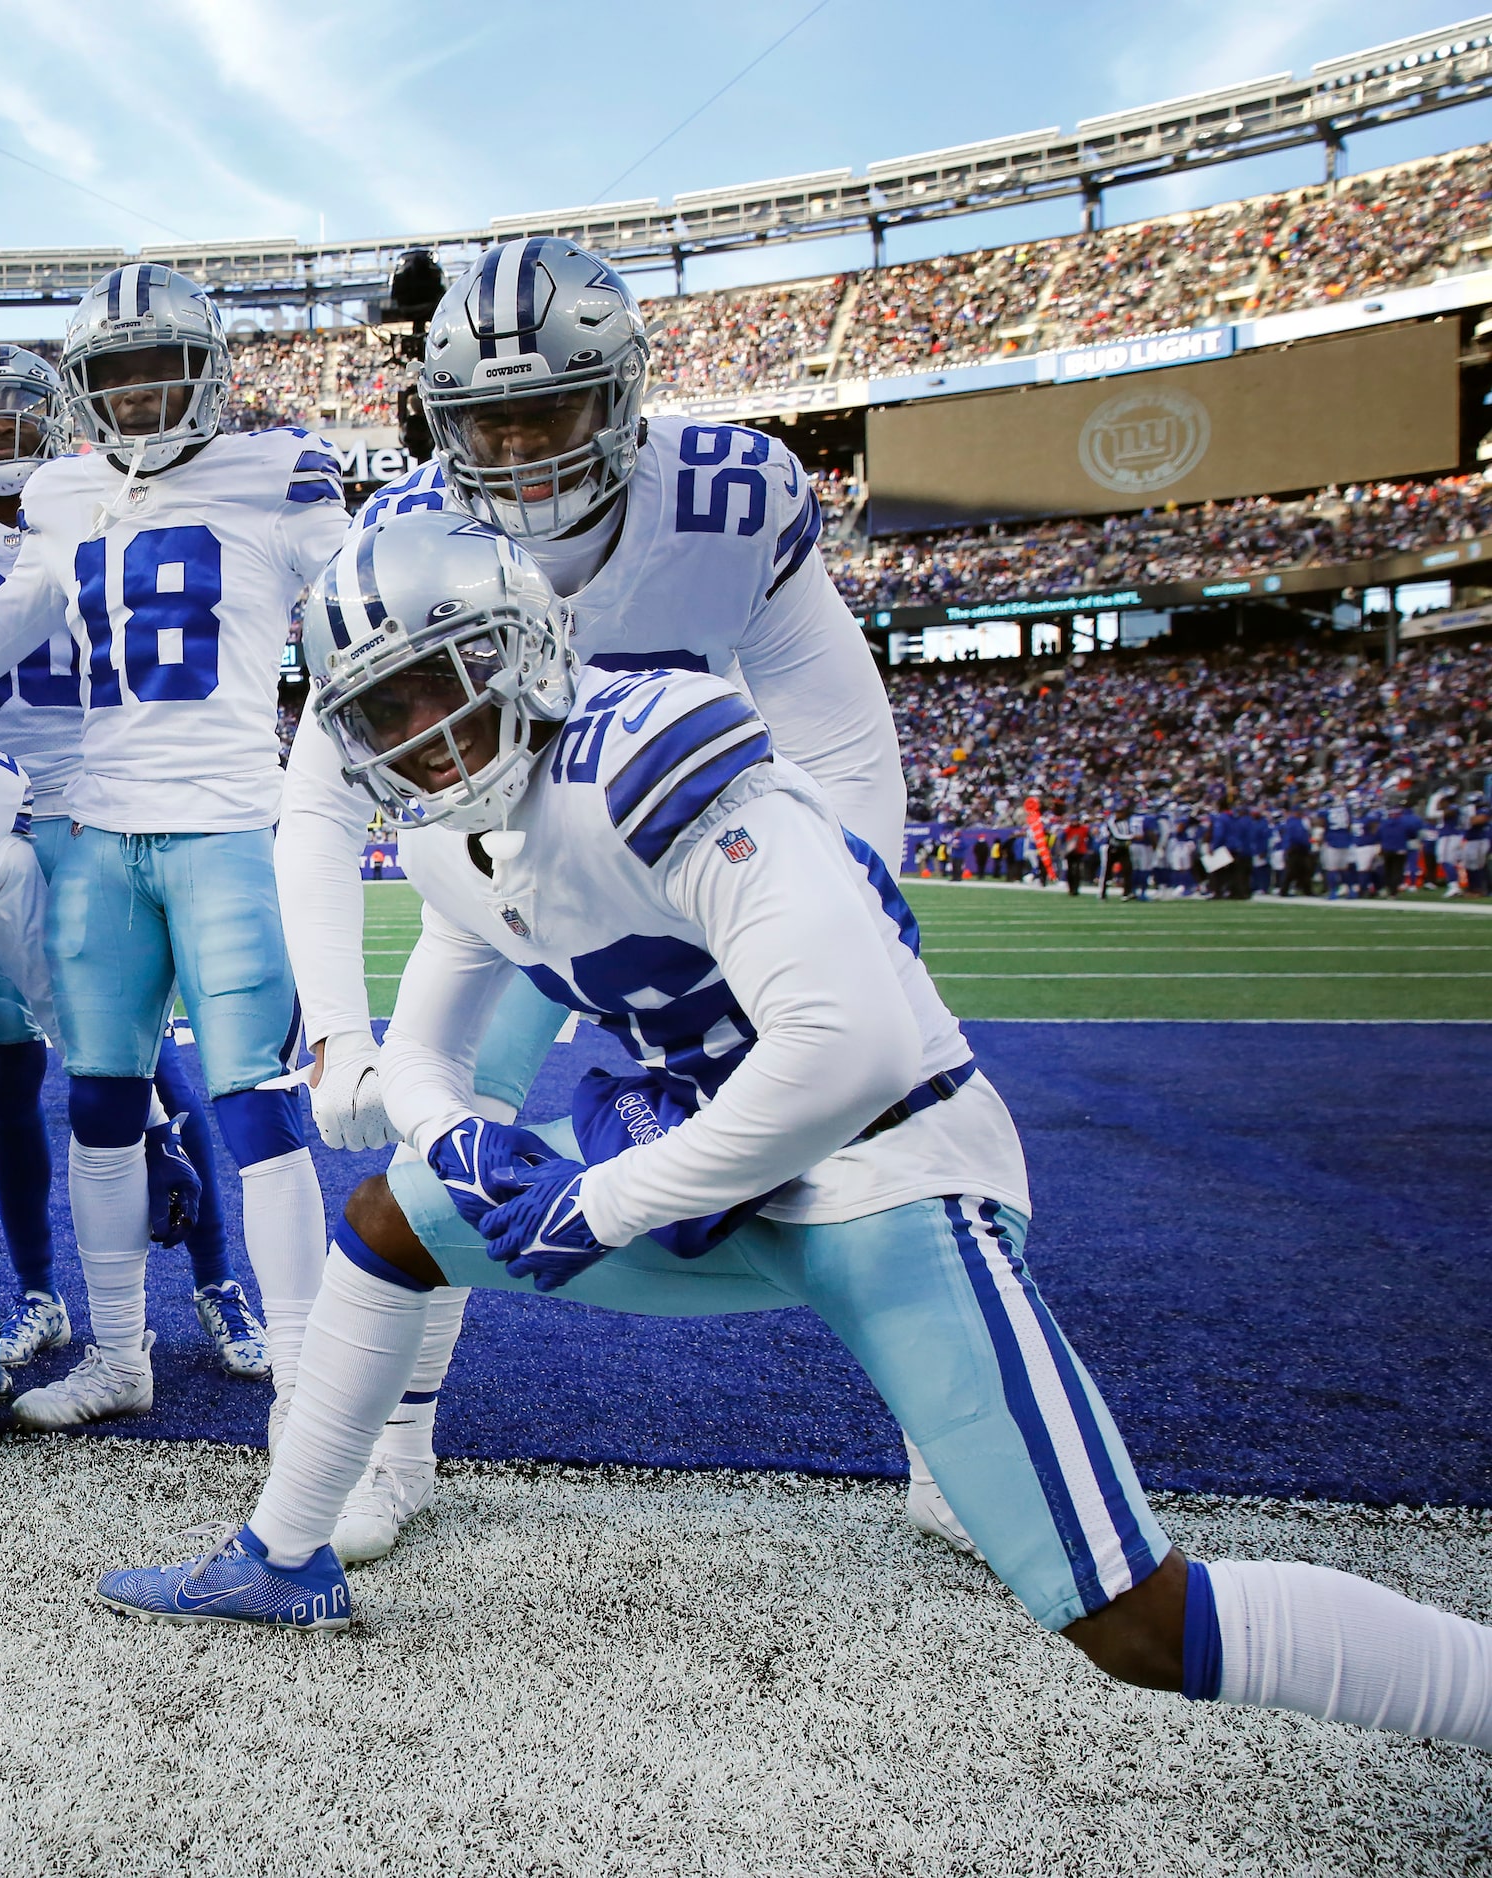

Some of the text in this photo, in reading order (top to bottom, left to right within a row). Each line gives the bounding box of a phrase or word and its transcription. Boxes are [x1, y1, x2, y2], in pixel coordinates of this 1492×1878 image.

[1065, 330, 1223, 377] BUD LIGHT
[485, 363, 532, 379] COWBOYS
[676, 425, 770, 537] 59
[1202, 581, 1251, 598] verizon
[74, 525, 222, 707] 18
[946, 606, 969, 620] The
[971, 603, 1007, 619] official
[1009, 601, 1028, 616] 5G
[1029, 597, 1076, 615] network
[1078, 596, 1092, 610] of
[1093, 594, 1112, 608] the
[349, 633, 386, 661] COWBOYS
